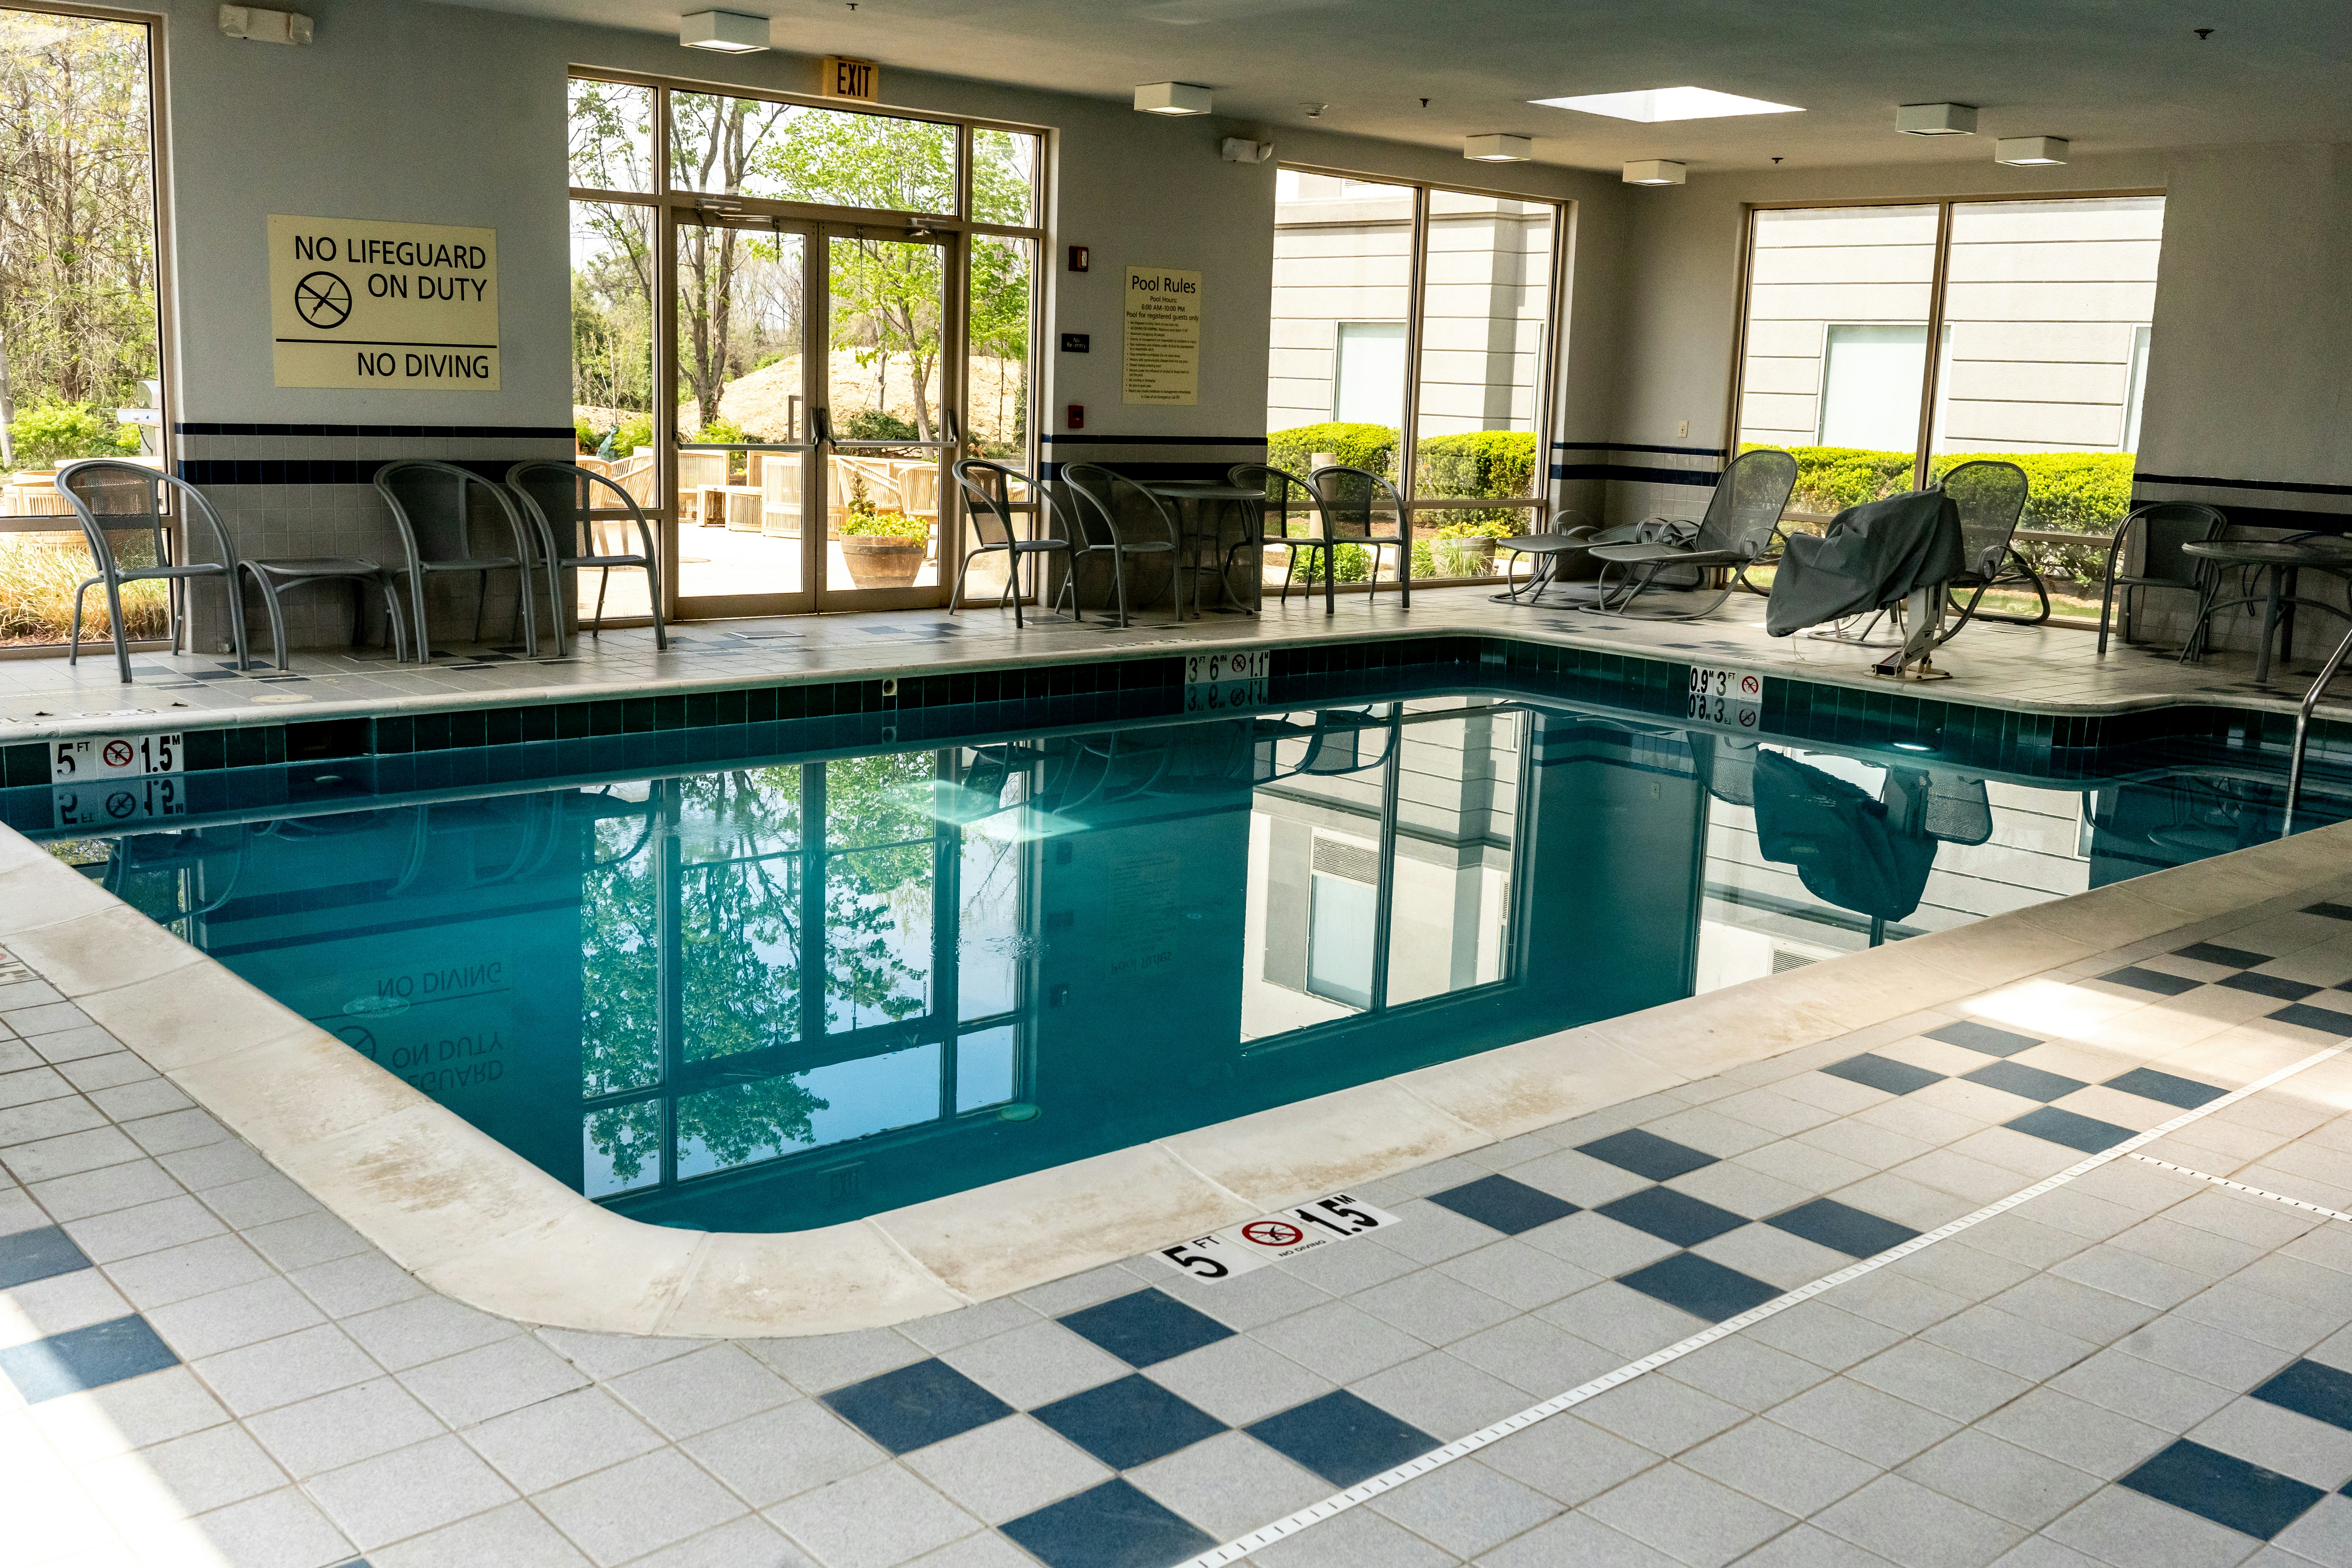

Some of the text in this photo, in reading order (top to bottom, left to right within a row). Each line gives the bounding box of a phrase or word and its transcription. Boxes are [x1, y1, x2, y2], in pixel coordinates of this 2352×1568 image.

[837, 62, 871, 97] EXIT
[295, 236, 486, 269] NO LIFEGUARD
[368, 273, 487, 301] ON DUTY
[1132, 275, 1196, 294] Pool Rules
[358, 353, 489, 379] NO DIVING
[1189, 657, 1198, 682] 3
[1209, 655, 1219, 681] 6
[1249, 652, 1263, 677] 1.1
[1690, 668, 1708, 693] 0.9
[1716, 671, 1726, 696] 3
[57, 735, 181, 779] 5 FT 1.5 M
[1161, 1194, 1379, 1278] 5 FT 1.5 M
[1294, 1240, 1327, 1251] DIVING
